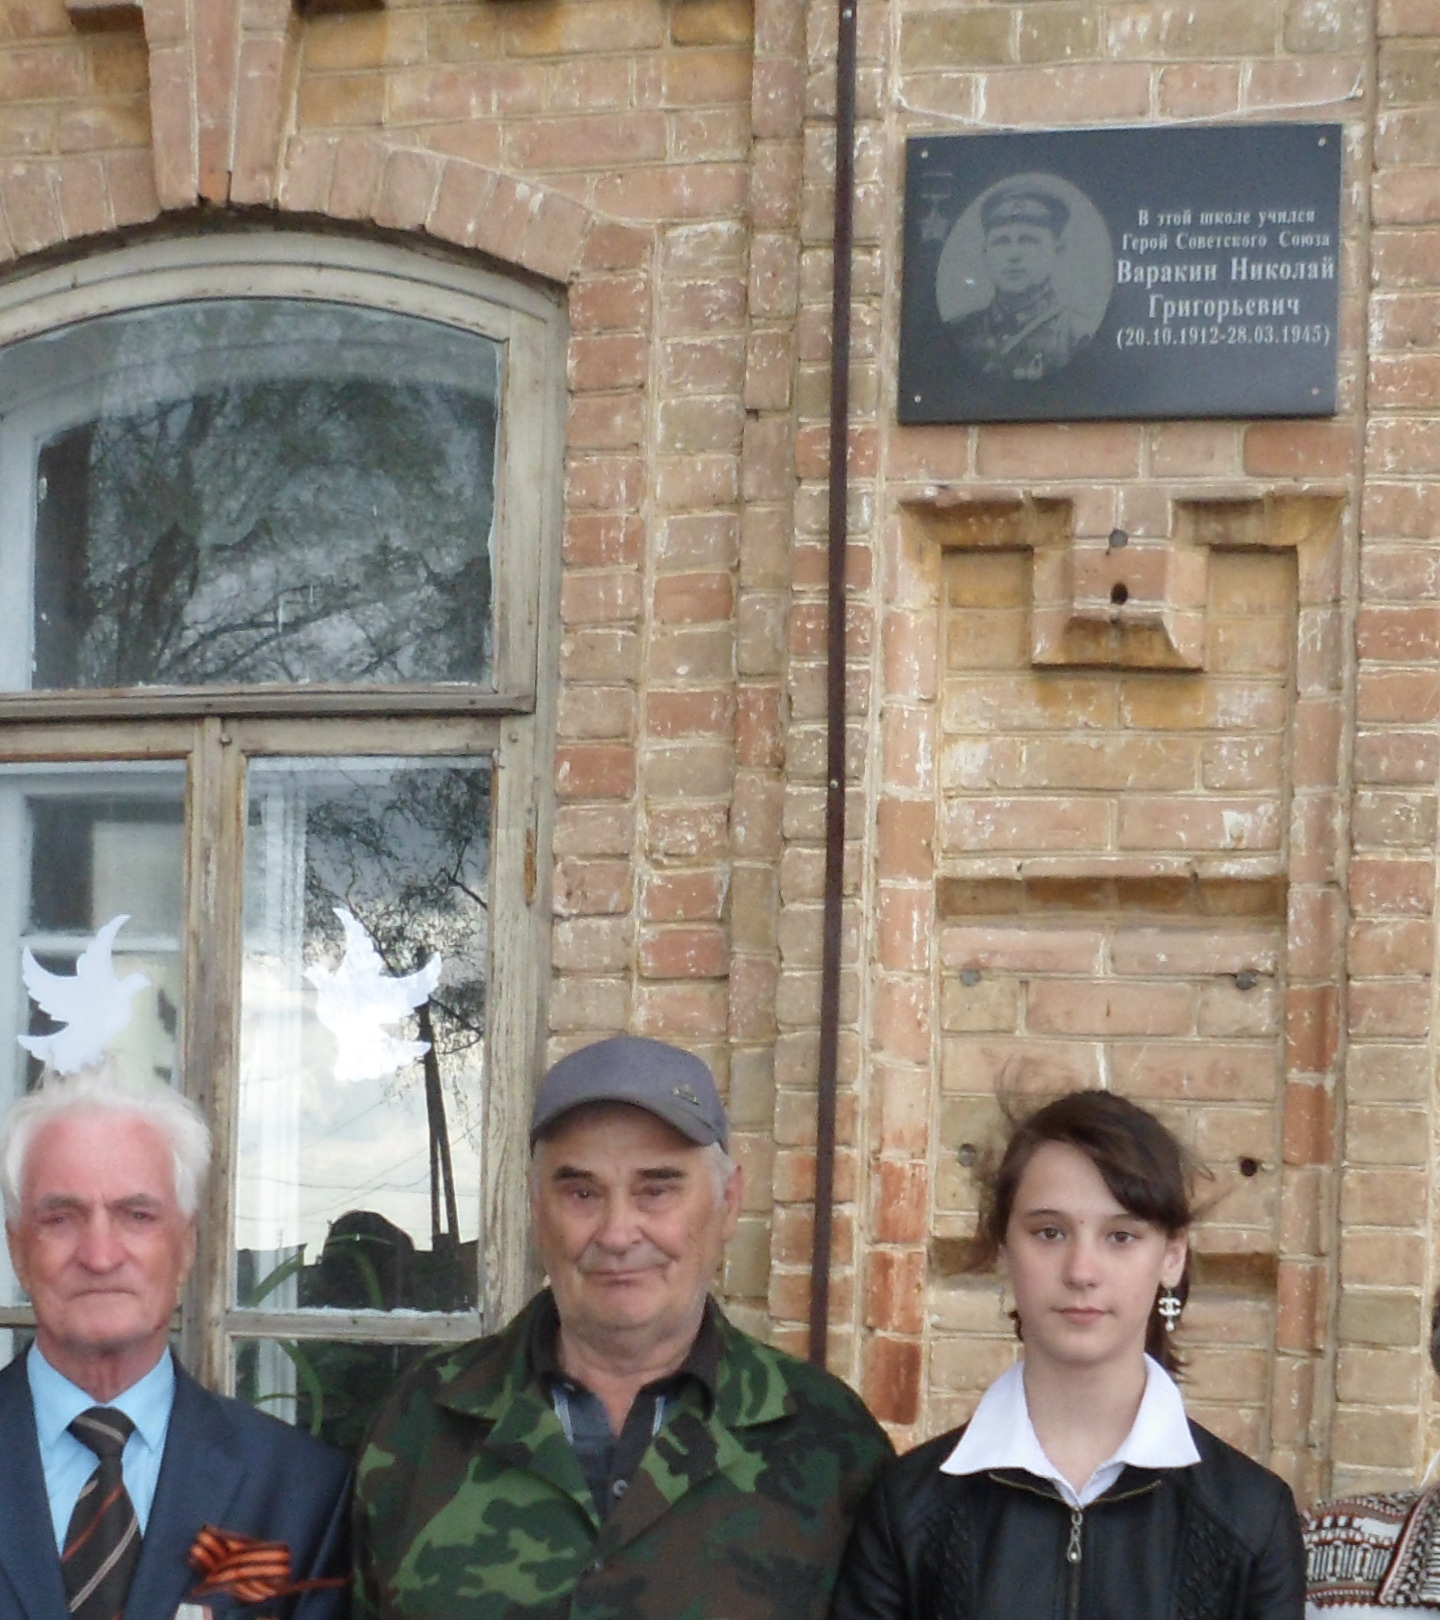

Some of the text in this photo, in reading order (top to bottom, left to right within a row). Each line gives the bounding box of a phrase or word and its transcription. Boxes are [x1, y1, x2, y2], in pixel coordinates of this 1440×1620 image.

[1138, 209, 1316, 228] В этой школе учился
[1122, 230, 1330, 254] Герой Советского Союза
[1117, 255, 1335, 289] Варакин Николай
[1148, 294, 1301, 324] Григорьевич
[1116, 324, 1330, 350] (20.10.1912-28.03.1945)
